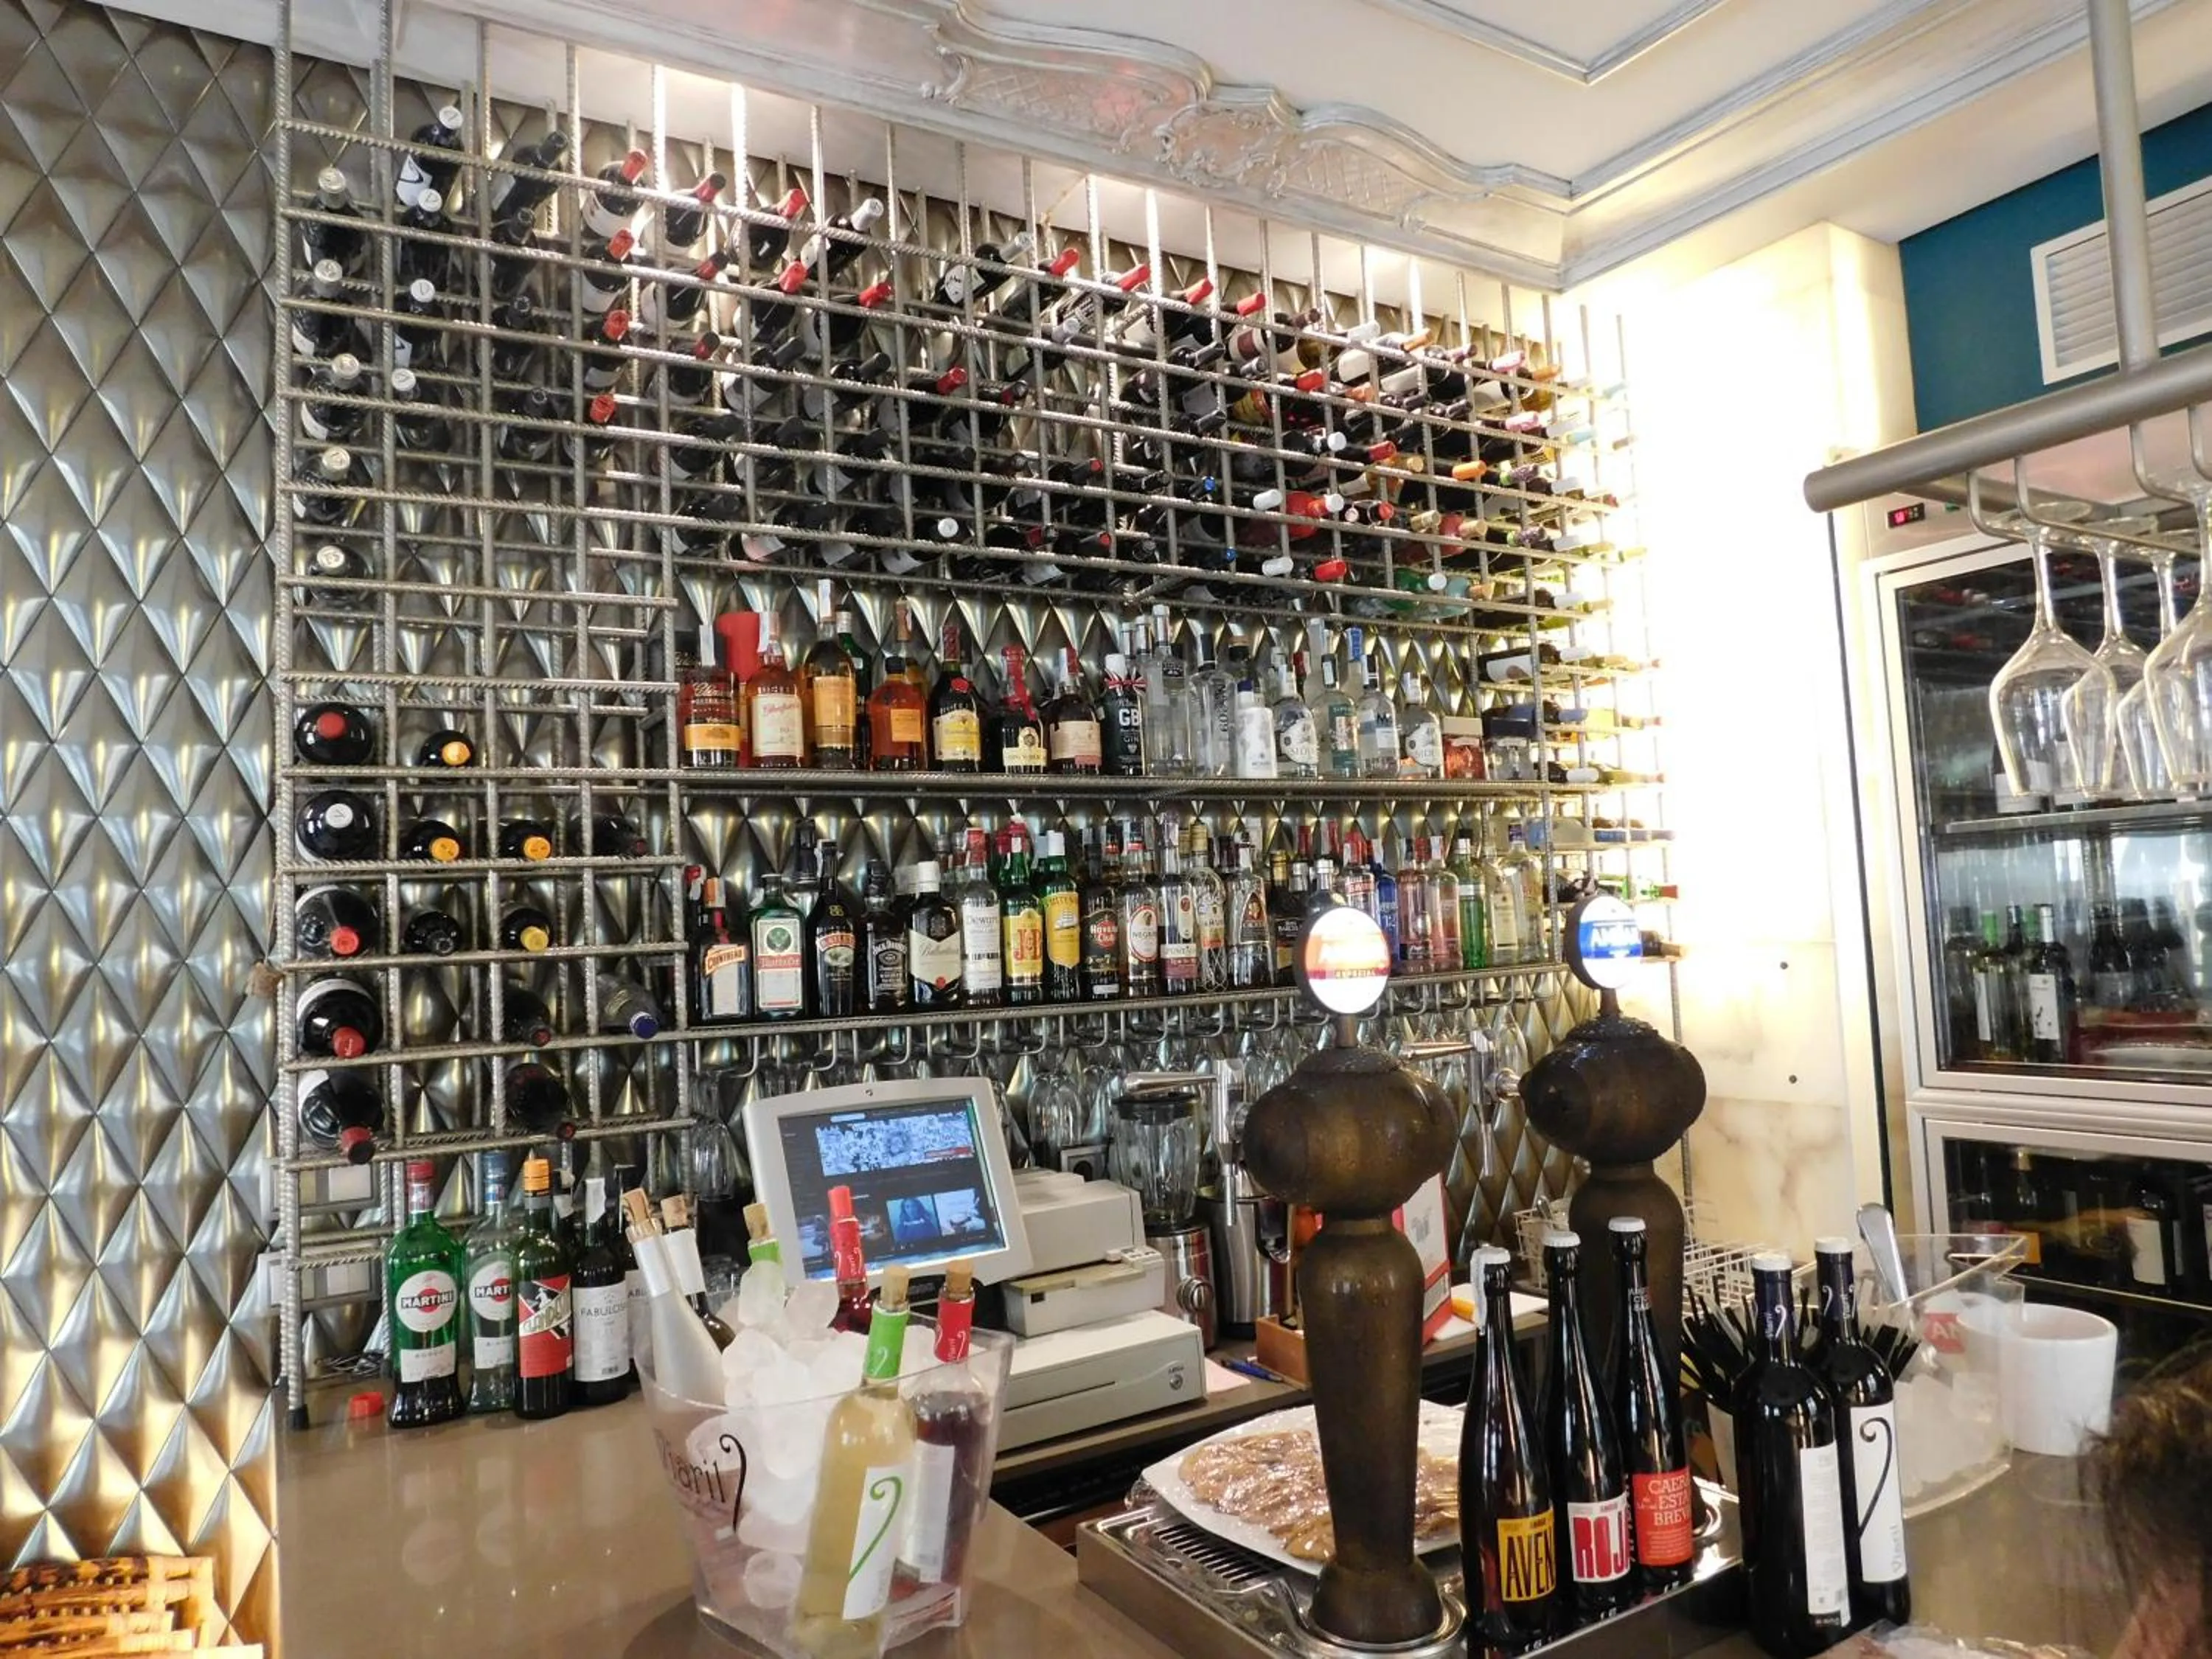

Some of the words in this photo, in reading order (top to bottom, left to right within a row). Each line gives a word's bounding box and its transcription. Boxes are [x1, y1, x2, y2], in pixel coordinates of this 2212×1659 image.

[1119, 708, 1141, 726] GB
[475, 1285, 509, 1298] MART
[402, 1292, 452, 1309] MARTINI
